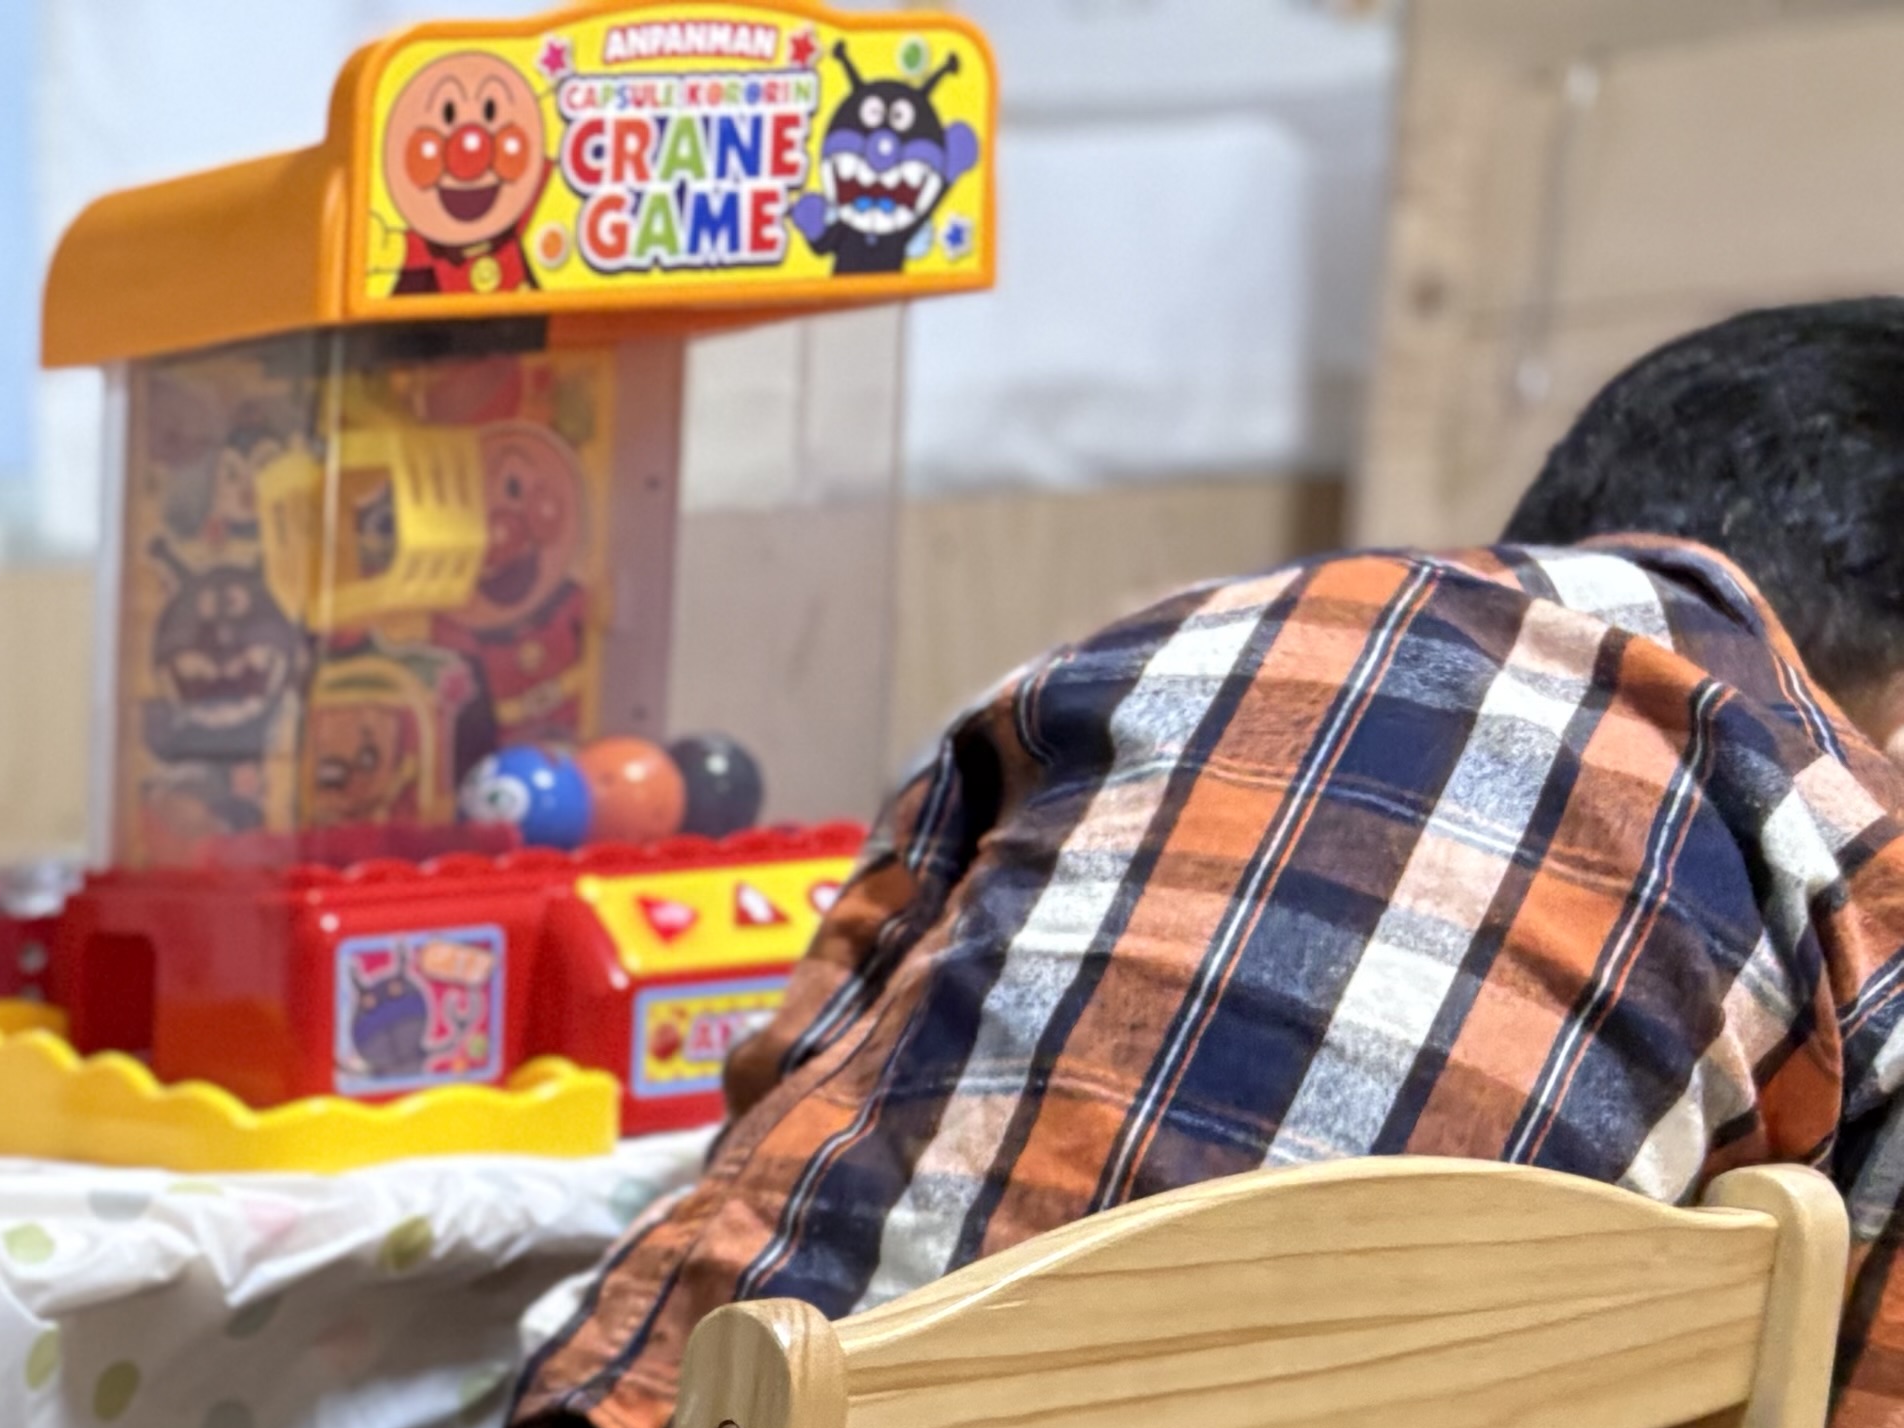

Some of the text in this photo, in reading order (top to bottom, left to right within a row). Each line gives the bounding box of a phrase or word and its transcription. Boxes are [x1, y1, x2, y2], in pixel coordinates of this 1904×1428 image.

[604, 22, 778, 62] ANPANMAN
[564, 78, 812, 112] CAPSULE KORORIN
[569, 112, 802, 186] CRANE
[585, 188, 781, 261] GAME
